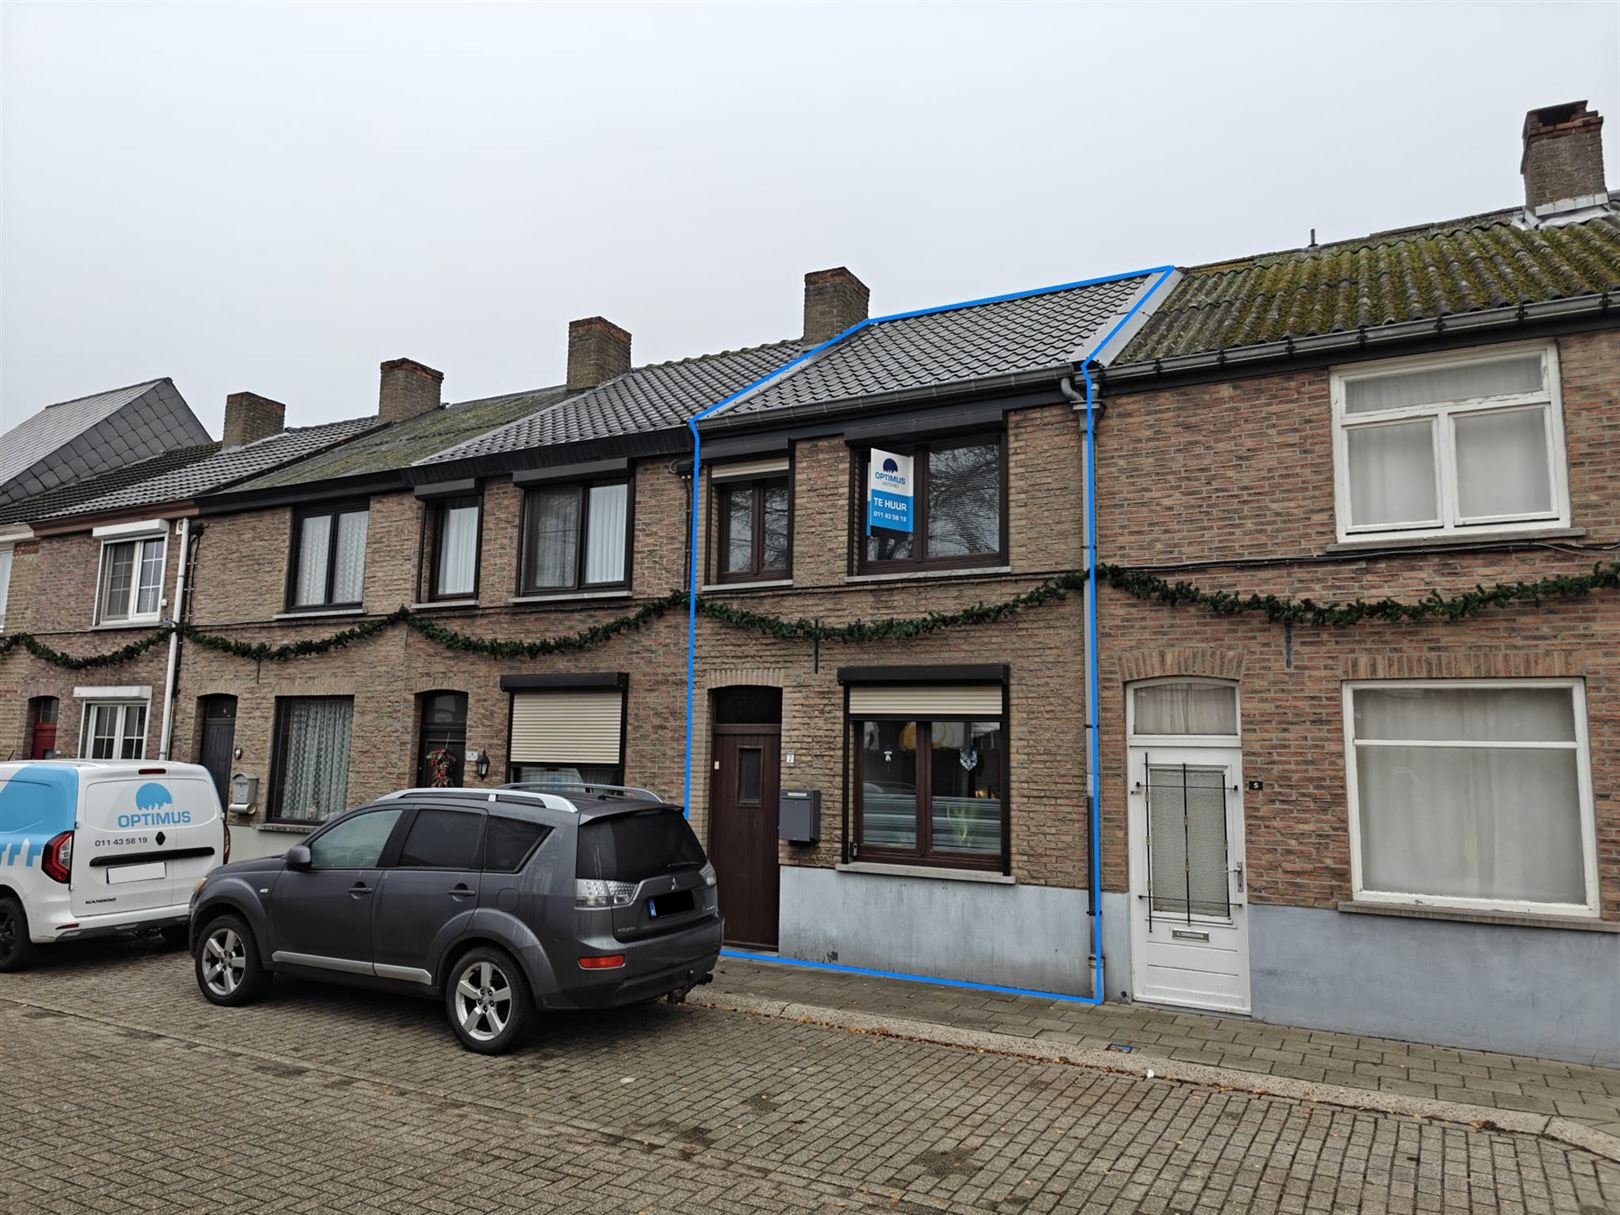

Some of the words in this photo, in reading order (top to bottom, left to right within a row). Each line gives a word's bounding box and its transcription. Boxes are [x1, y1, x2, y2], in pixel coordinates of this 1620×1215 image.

[875, 472, 906, 485] OPTIMUS
[873, 497, 883, 507] TE
[884, 499, 907, 512] HUUR
[873, 510, 884, 518] 011
[117, 811, 192, 828] OPTIMUS
[94, 839, 111, 847] 011
[113, 838, 124, 846] 43
[125, 837, 136, 845] 58
[138, 836, 148, 844] 19
